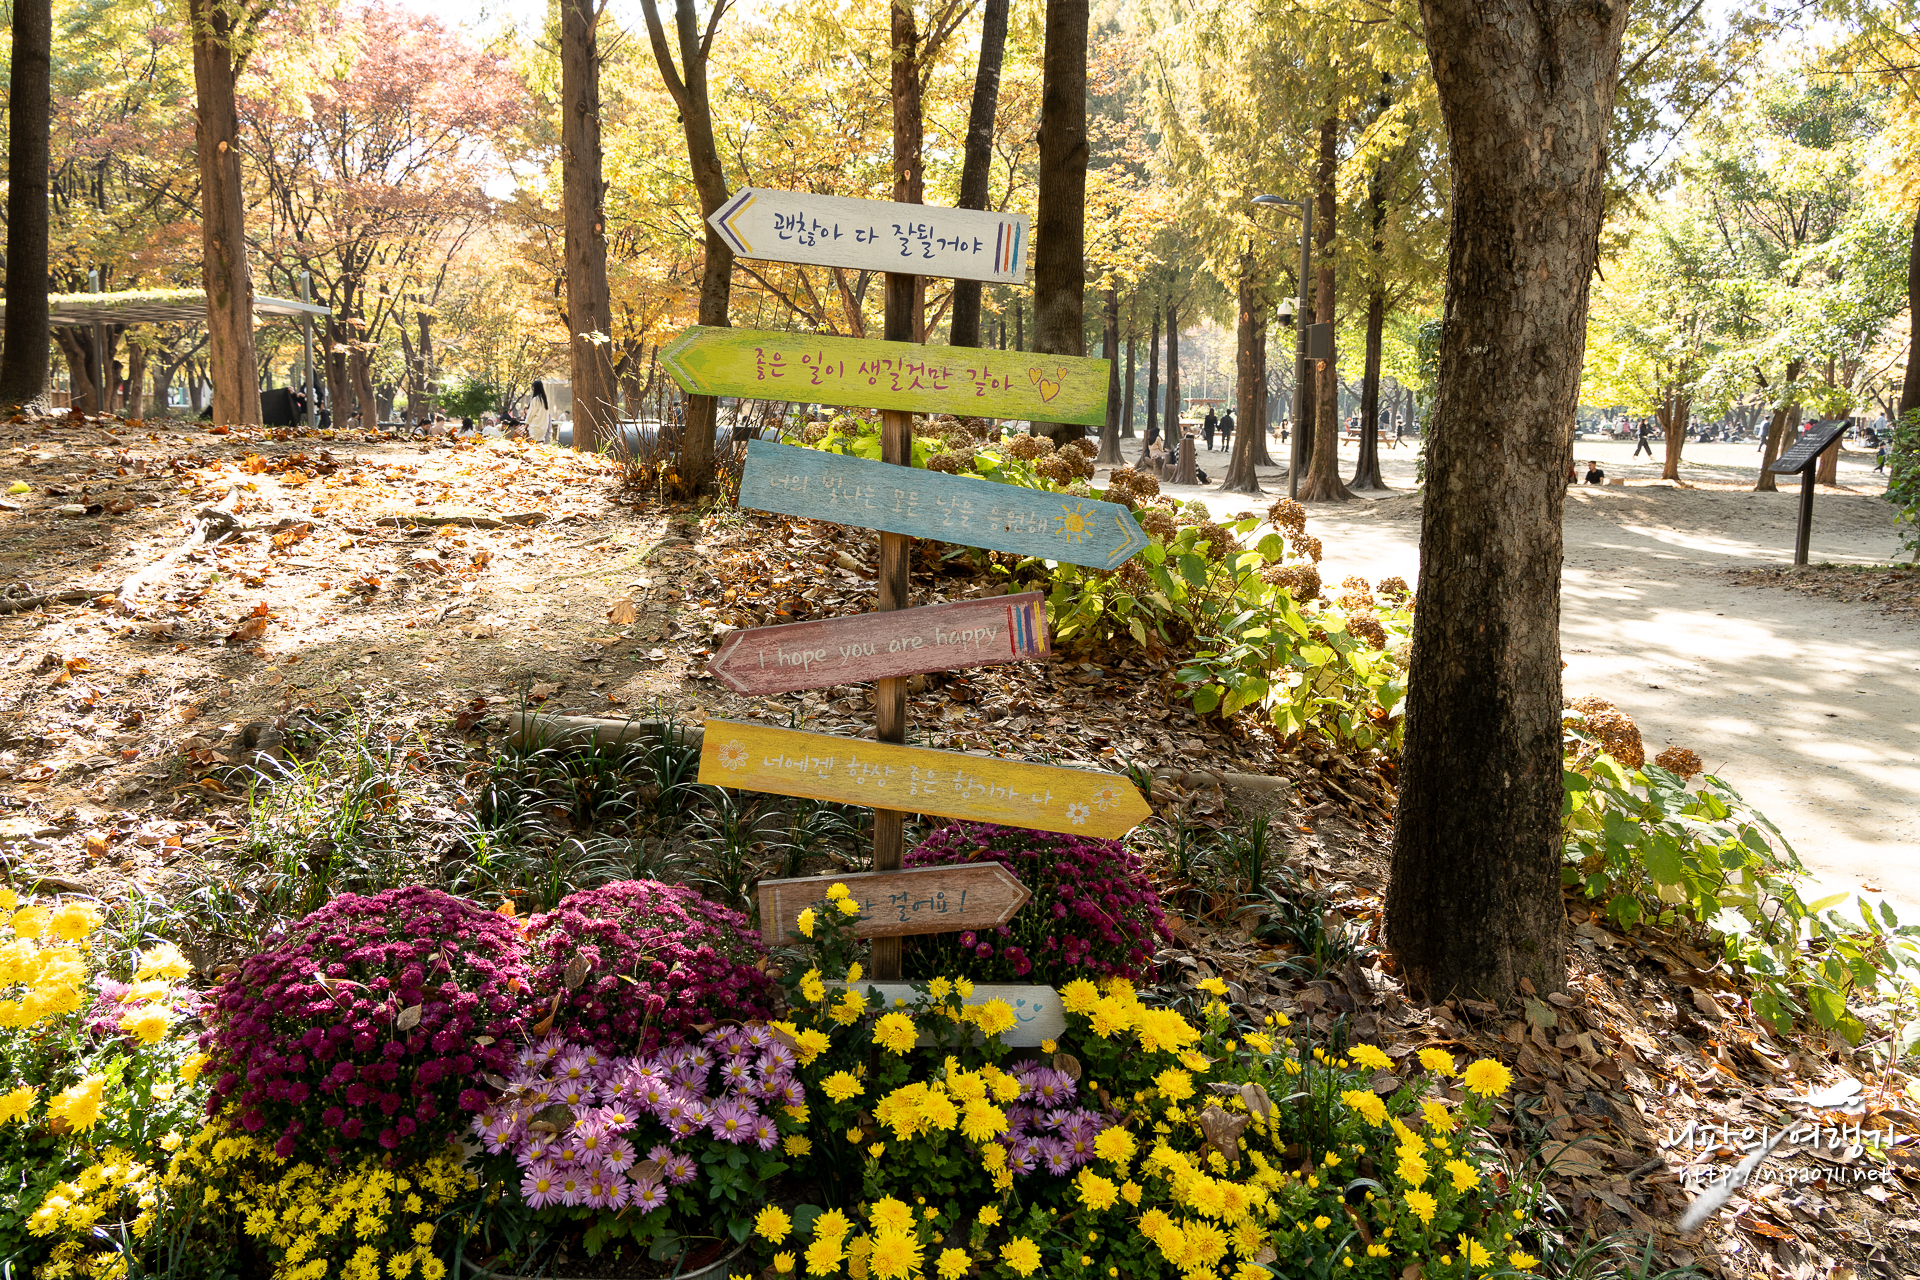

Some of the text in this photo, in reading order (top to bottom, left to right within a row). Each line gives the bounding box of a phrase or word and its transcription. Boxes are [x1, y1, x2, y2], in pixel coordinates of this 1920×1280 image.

[773, 211, 983, 259] 괜찮아 다 잘될거야
[754, 347, 1014, 397] 좋은 일이 생길것만 같아
[770, 473, 1048, 534] 너의 빛나는 모든 날을 응원해
[759, 625, 998, 673] I hope you are happy
[763, 753, 1054, 806] 너에겐 항상 좋은 향기가 나
